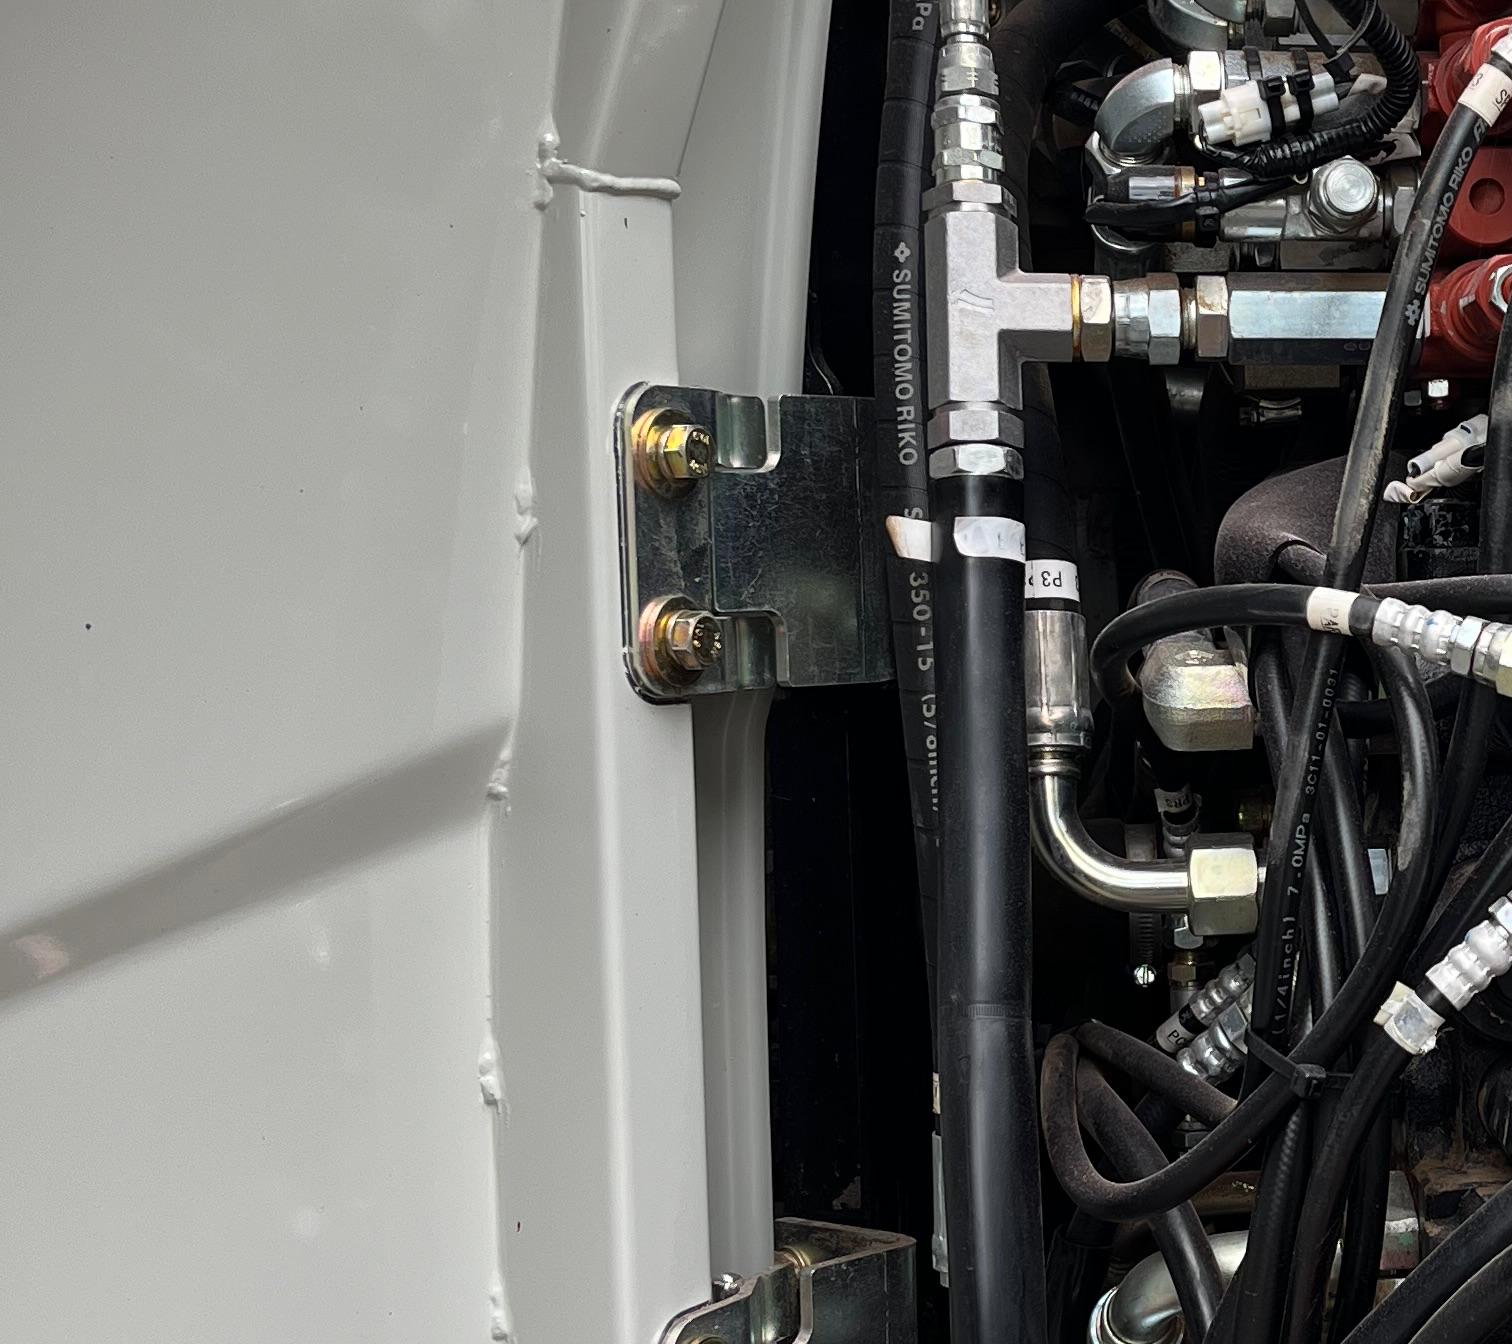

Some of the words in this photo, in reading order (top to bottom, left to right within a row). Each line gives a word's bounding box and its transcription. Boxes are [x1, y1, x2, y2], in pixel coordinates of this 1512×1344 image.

[1414, 191, 1455, 296] SUMITOMO
[1449, 146, 1473, 190] RIKO
[893, 268, 915, 402] SUMITOMO
[895, 404, 919, 467] RIKO
[910, 571, 936, 672] 350-15
[1041, 570, 1062, 588] P3
